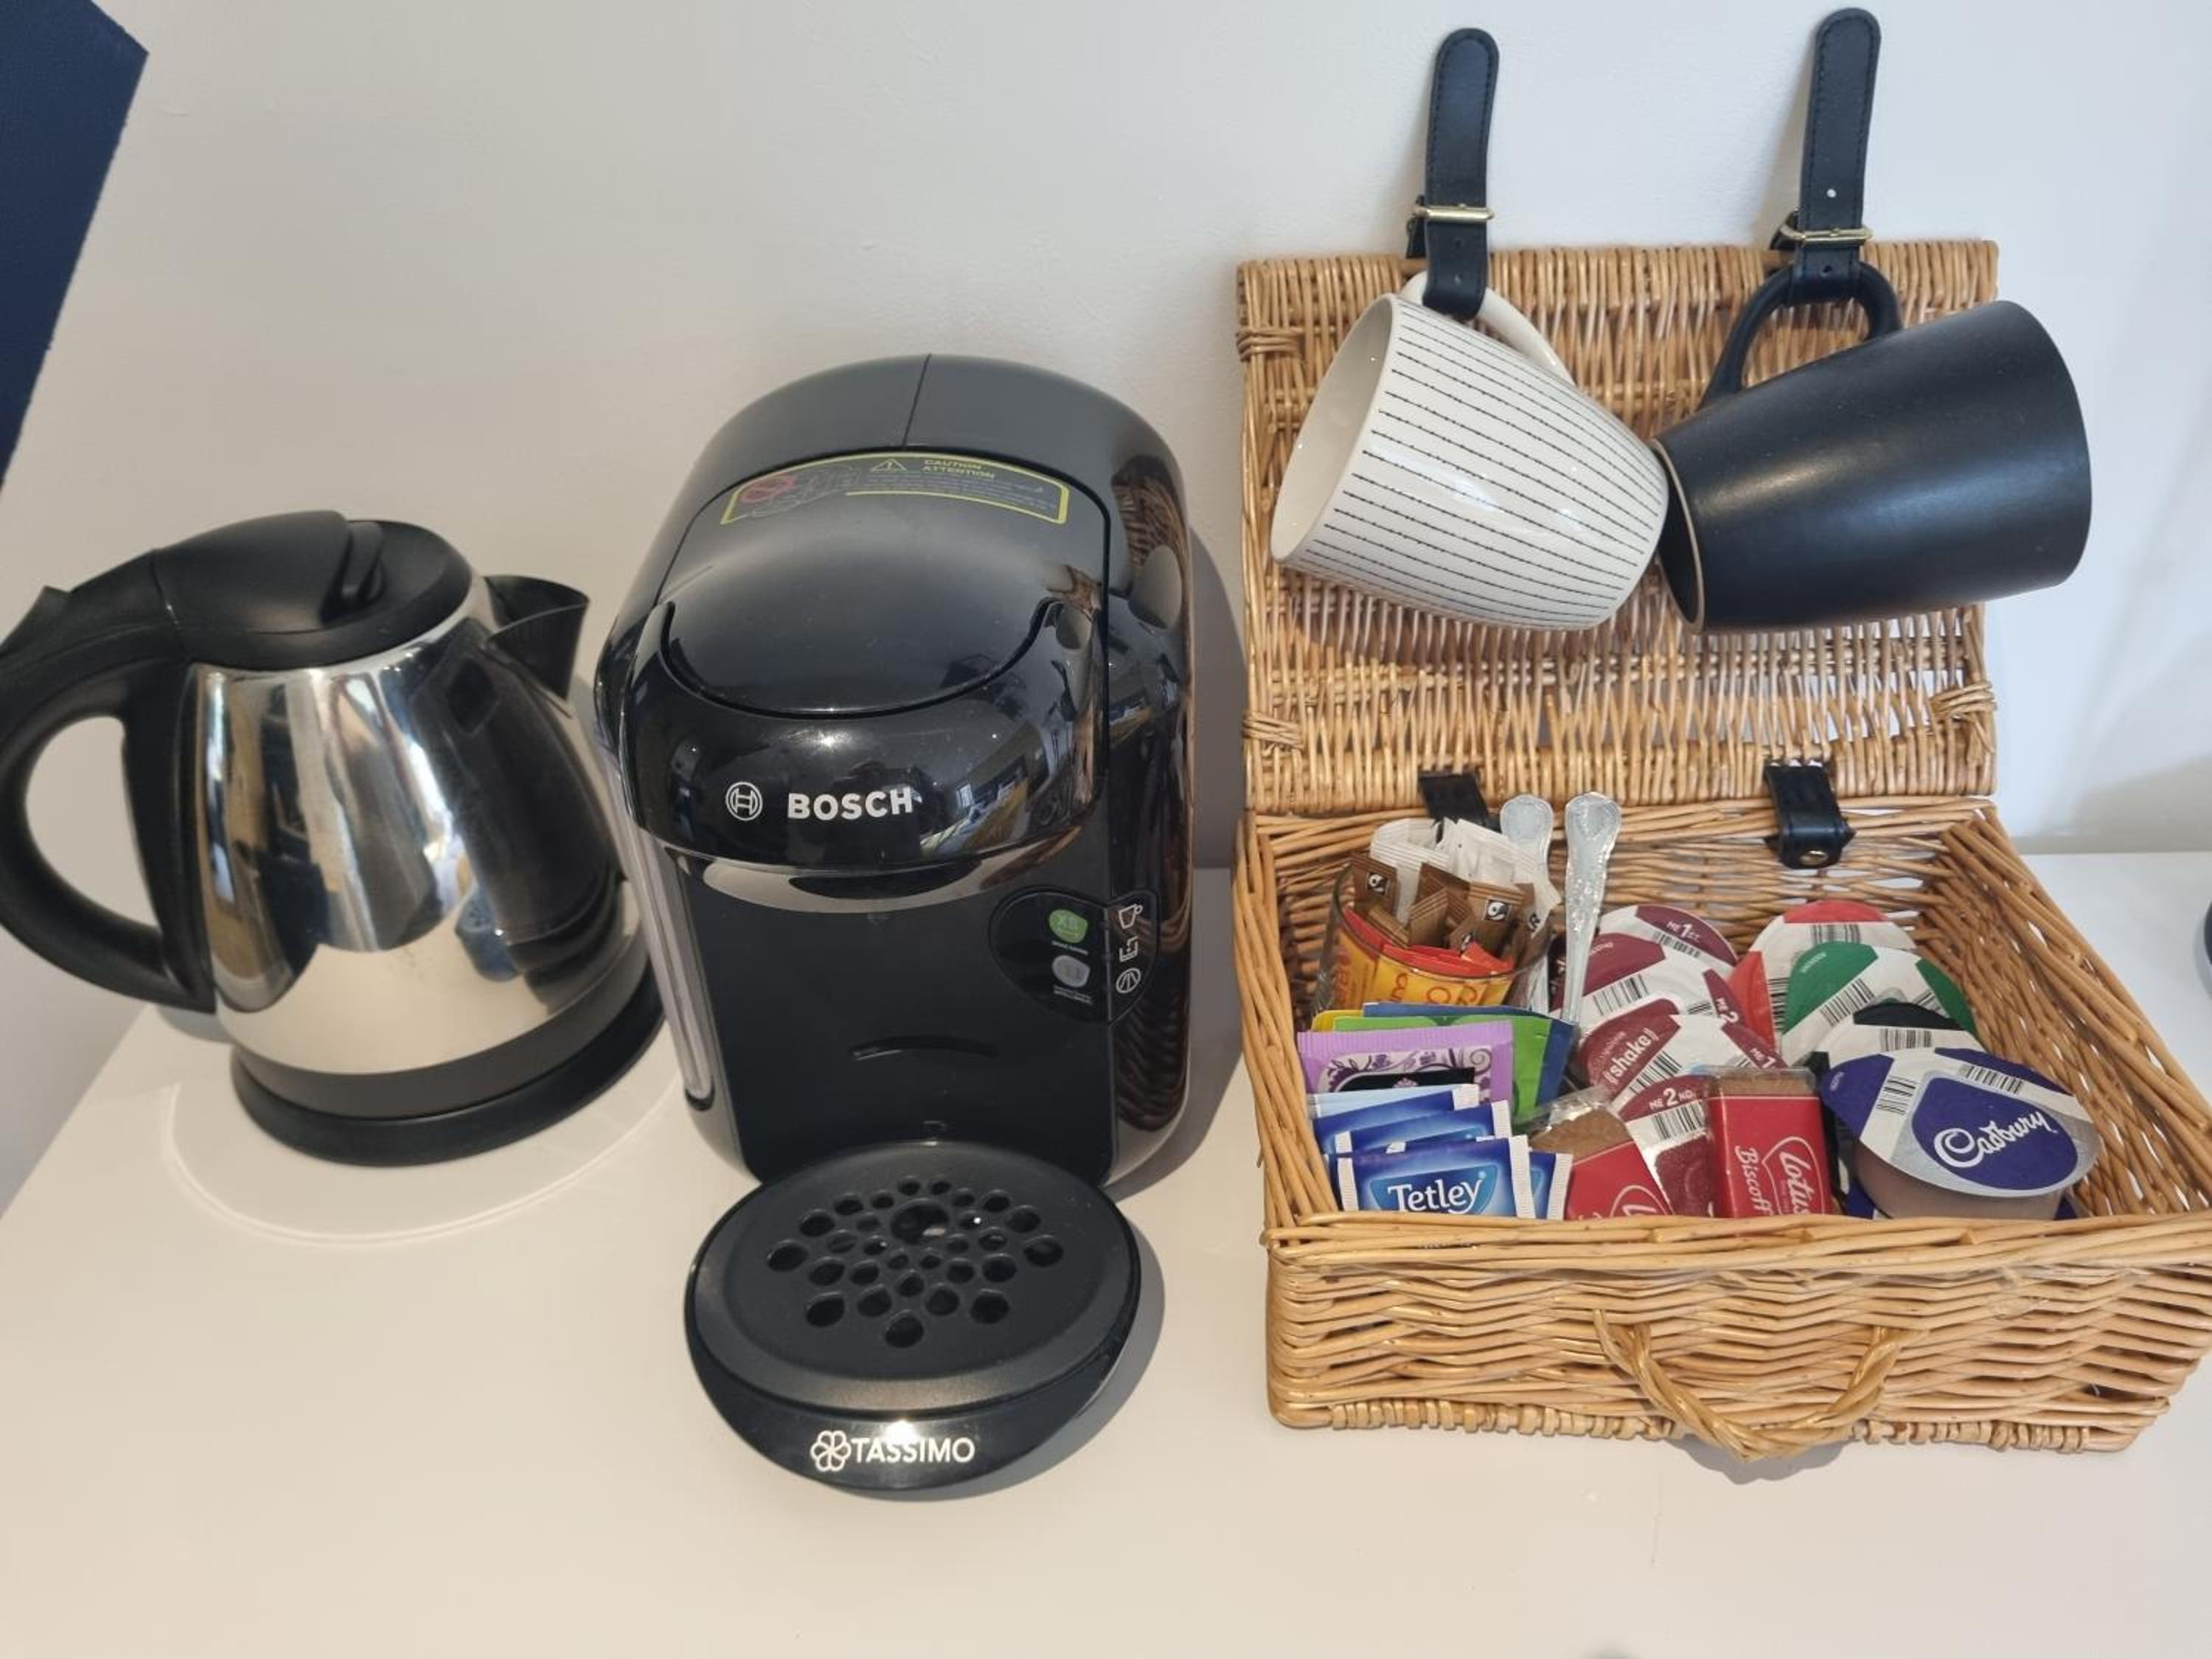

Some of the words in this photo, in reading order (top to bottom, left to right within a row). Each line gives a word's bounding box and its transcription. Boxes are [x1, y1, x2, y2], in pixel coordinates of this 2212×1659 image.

[921, 465, 995, 479] ATTENTION
[924, 459, 981, 470] CAUTION
[787, 786, 914, 821] BOSCH
[1933, 1110, 2058, 1168] Cadbury
[1387, 1178, 1484, 1214] Tetley
[1734, 1145, 1774, 1214] Biscoff
[1779, 1151, 1815, 1214] Lotus
[851, 1436, 975, 1464] TASSIMO
